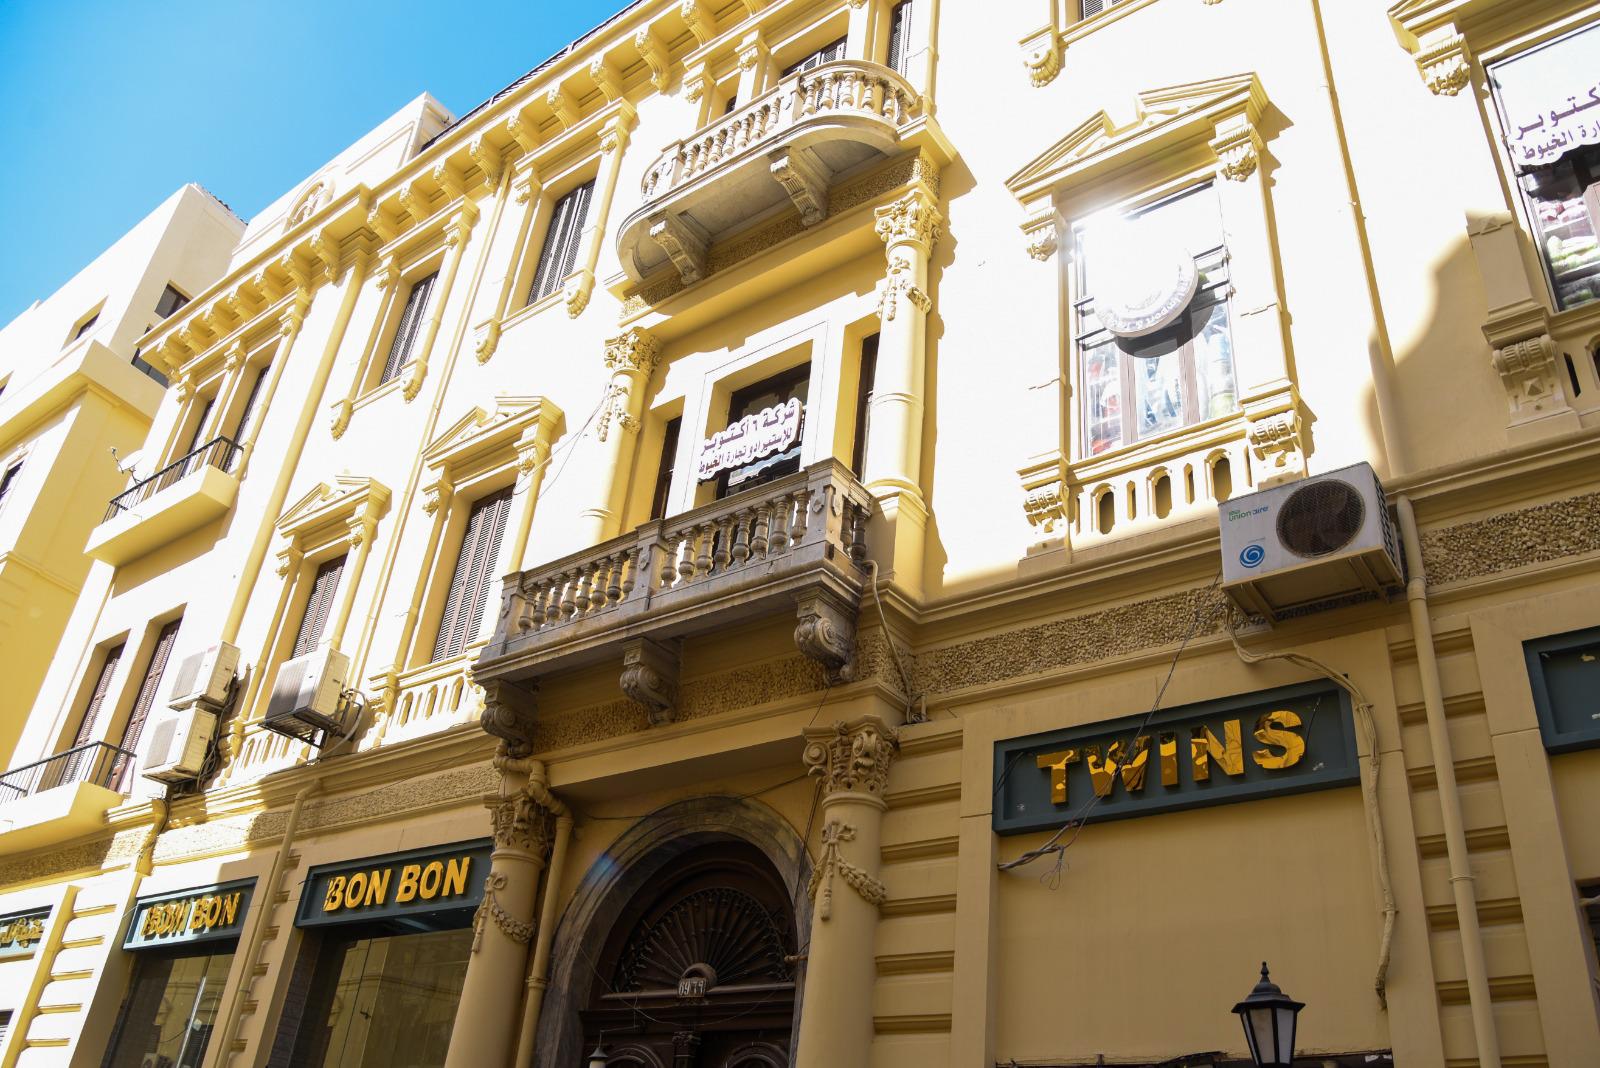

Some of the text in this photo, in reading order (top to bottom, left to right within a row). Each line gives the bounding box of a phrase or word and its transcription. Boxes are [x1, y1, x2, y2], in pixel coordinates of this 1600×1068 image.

[1516, 82, 1600, 140] كتوبر
[1523, 130, 1574, 159] الخيوط
[763, 401, 795, 428] شركة
[701, 419, 749, 456] أكتوبر
[699, 453, 724, 474] الخيوط
[1036, 710, 1306, 805] TWINS
[323, 856, 471, 912] BON BON
[141, 892, 240, 937] BON BON
